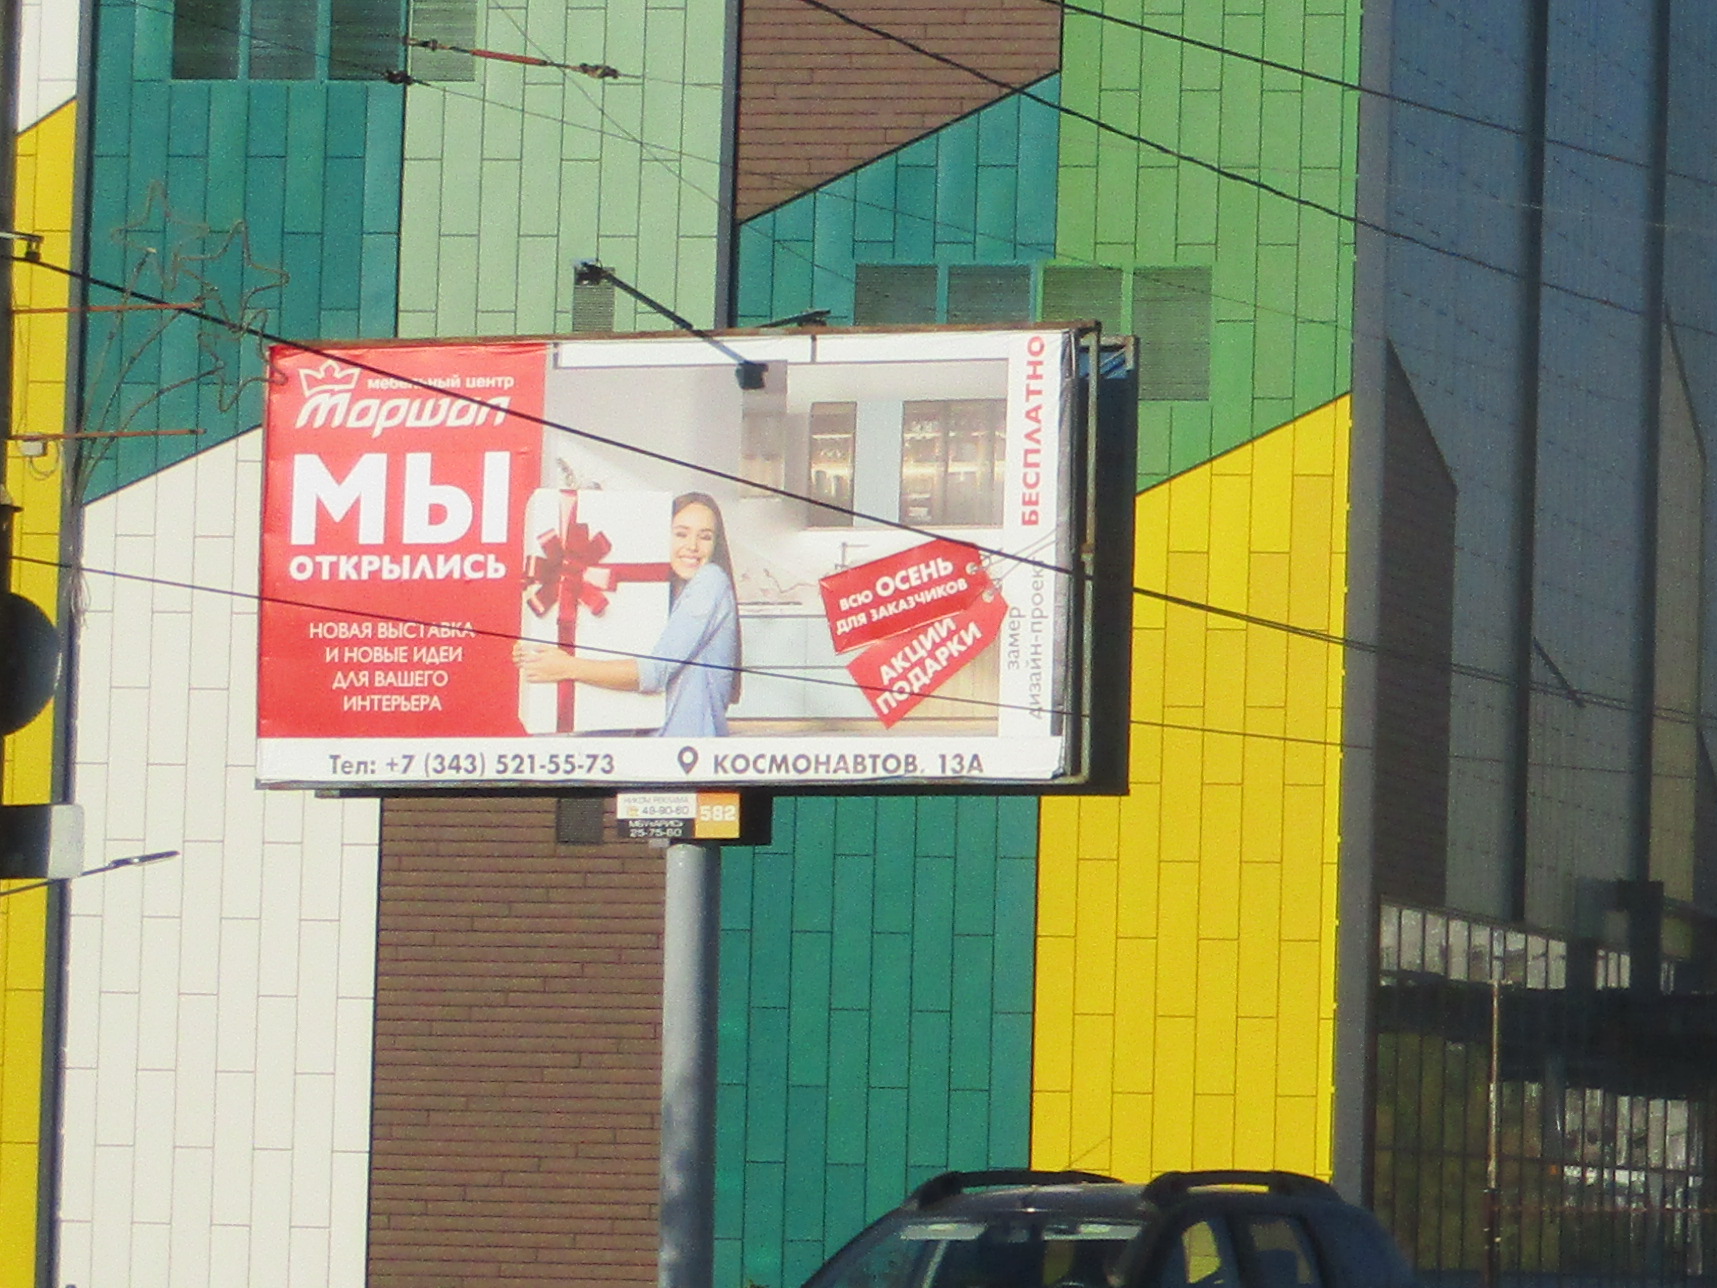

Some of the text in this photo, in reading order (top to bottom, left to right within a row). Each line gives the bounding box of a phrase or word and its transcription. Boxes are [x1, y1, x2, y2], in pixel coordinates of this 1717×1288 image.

[465, 375, 515, 390] центр
[295, 392, 511, 439] Маршал
[1021, 336, 1045, 527] БЕСПЛАТНО
[291, 451, 511, 545] МЫ
[289, 554, 507, 581] ОТКРЫЛИСЬ
[838, 556, 954, 612] ВСЮ ОСЕНЬ
[835, 577, 968, 636] ДЛЯ ЗАКАЗЧИКОВ
[309, 621, 477, 639] НОВАЯ ВЫСТАВКА
[1007, 606, 1026, 671] замер
[324, 645, 464, 665] И НОВЫЕ ИДЕИ
[878, 617, 957, 686] АКЦИИ
[331, 669, 449, 690] ДЛЯ ВАШЕГО
[875, 621, 983, 715] ПОДАРКИ
[343, 694, 443, 712] ИНТЕРЬЕРА
[329, 752, 615, 778] Тел: +7 (343) 521-55-73
[938, 753, 985, 775] 13А
[700, 804, 737, 822] 582
